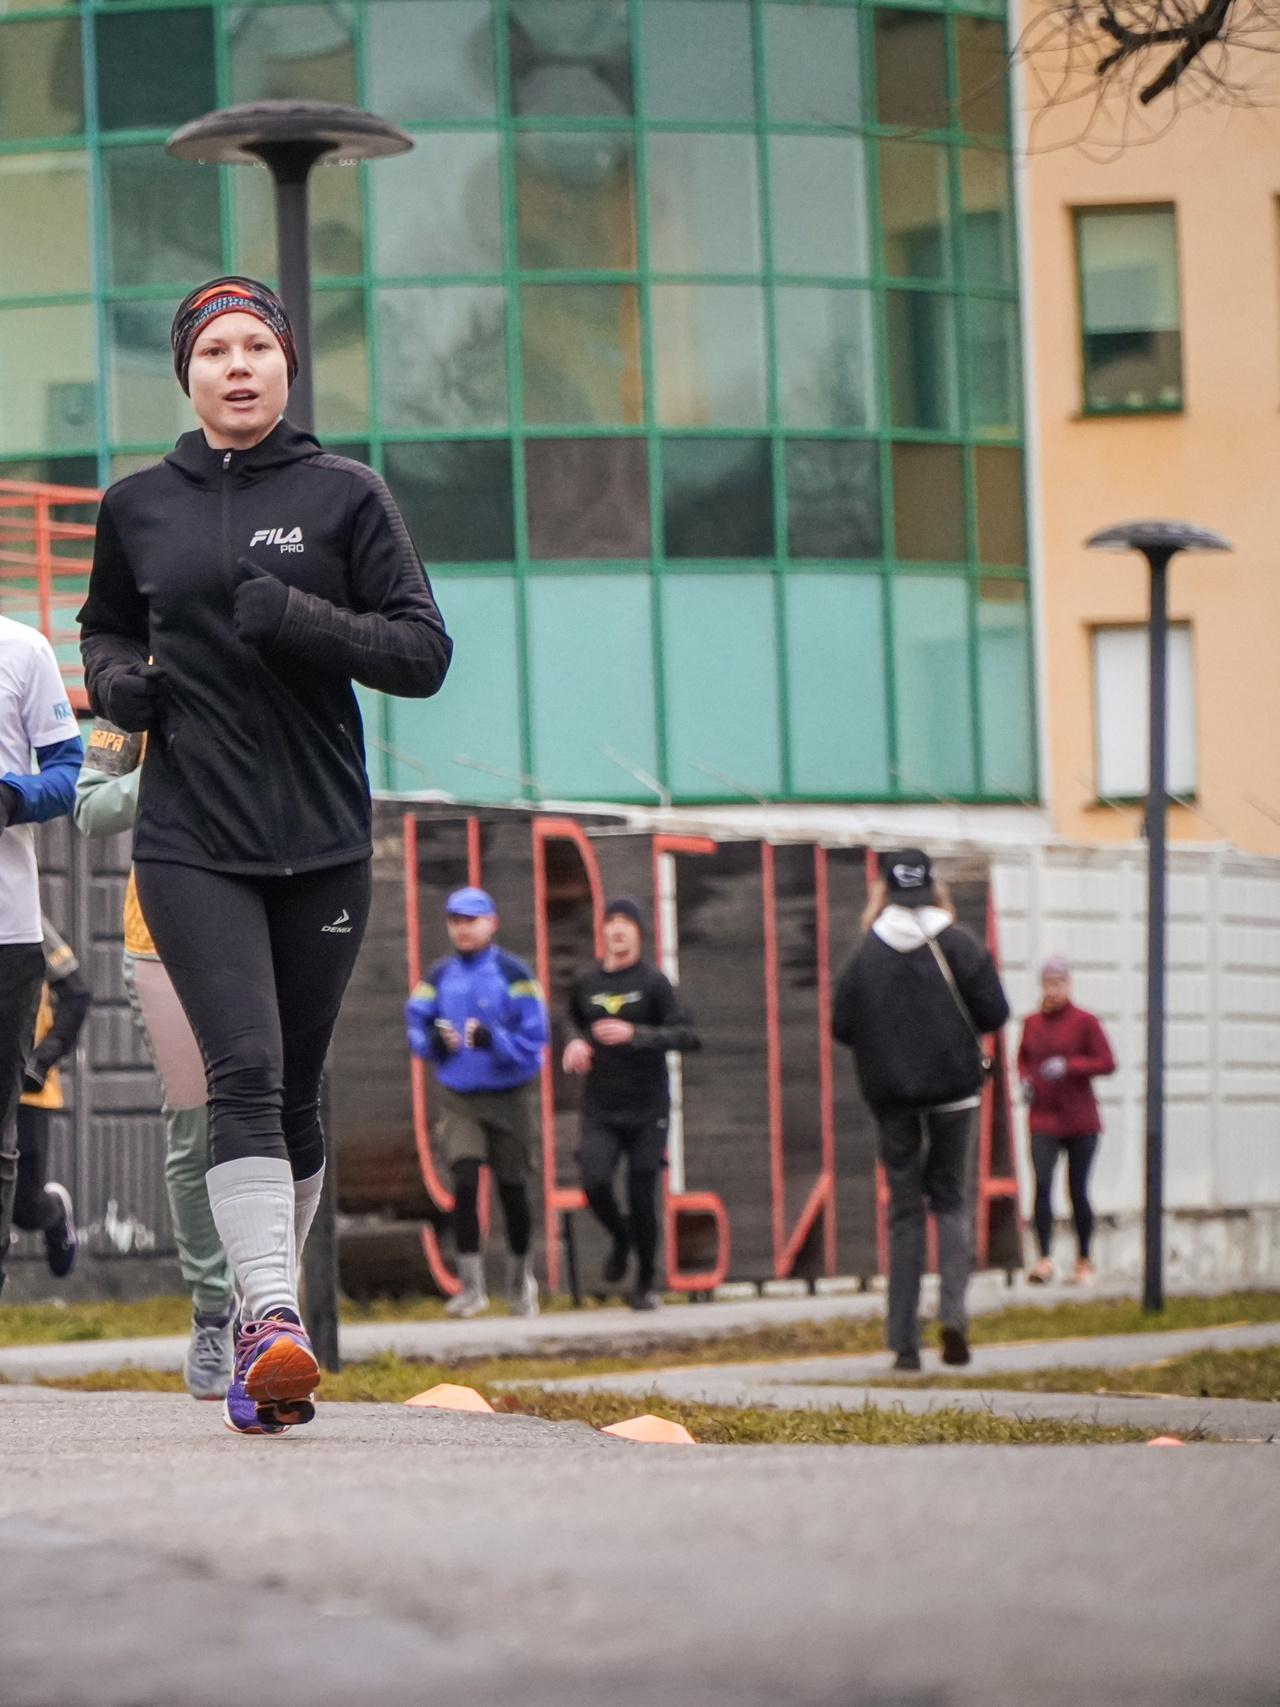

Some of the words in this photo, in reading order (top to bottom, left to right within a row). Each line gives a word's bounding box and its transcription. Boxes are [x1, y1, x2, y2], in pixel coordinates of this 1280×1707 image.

[249, 526, 303, 547] FILA
[280, 544, 305, 553] PRO
[321, 925, 353, 934] DEMIX
